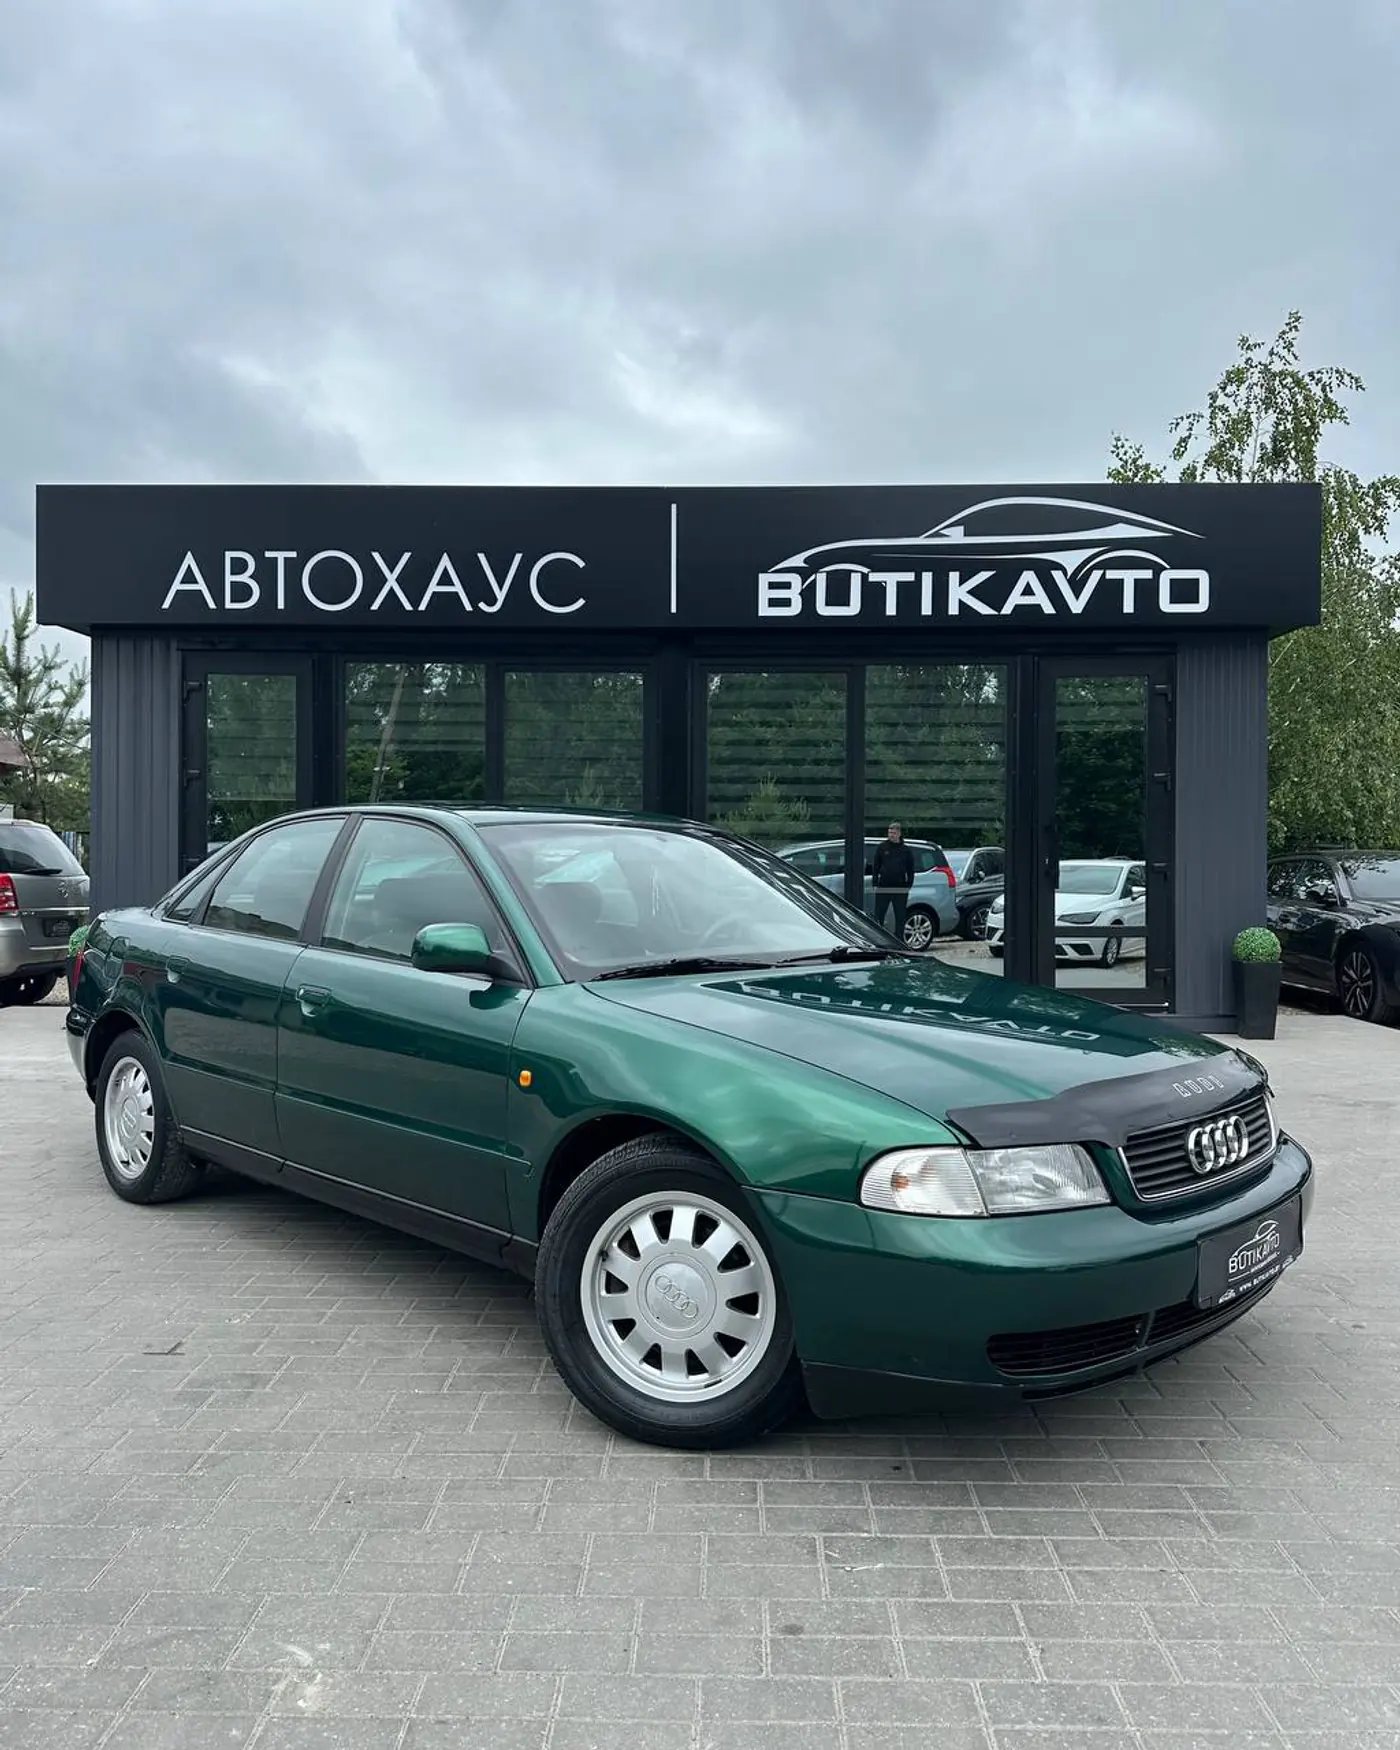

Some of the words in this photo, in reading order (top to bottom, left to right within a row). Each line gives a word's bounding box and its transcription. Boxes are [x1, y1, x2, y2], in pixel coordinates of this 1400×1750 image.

[161, 549, 587, 614] АВТОХАУС
[757, 568, 1211, 617] BUTIKAVTO
[1172, 1075, 1224, 1098] AUDI
